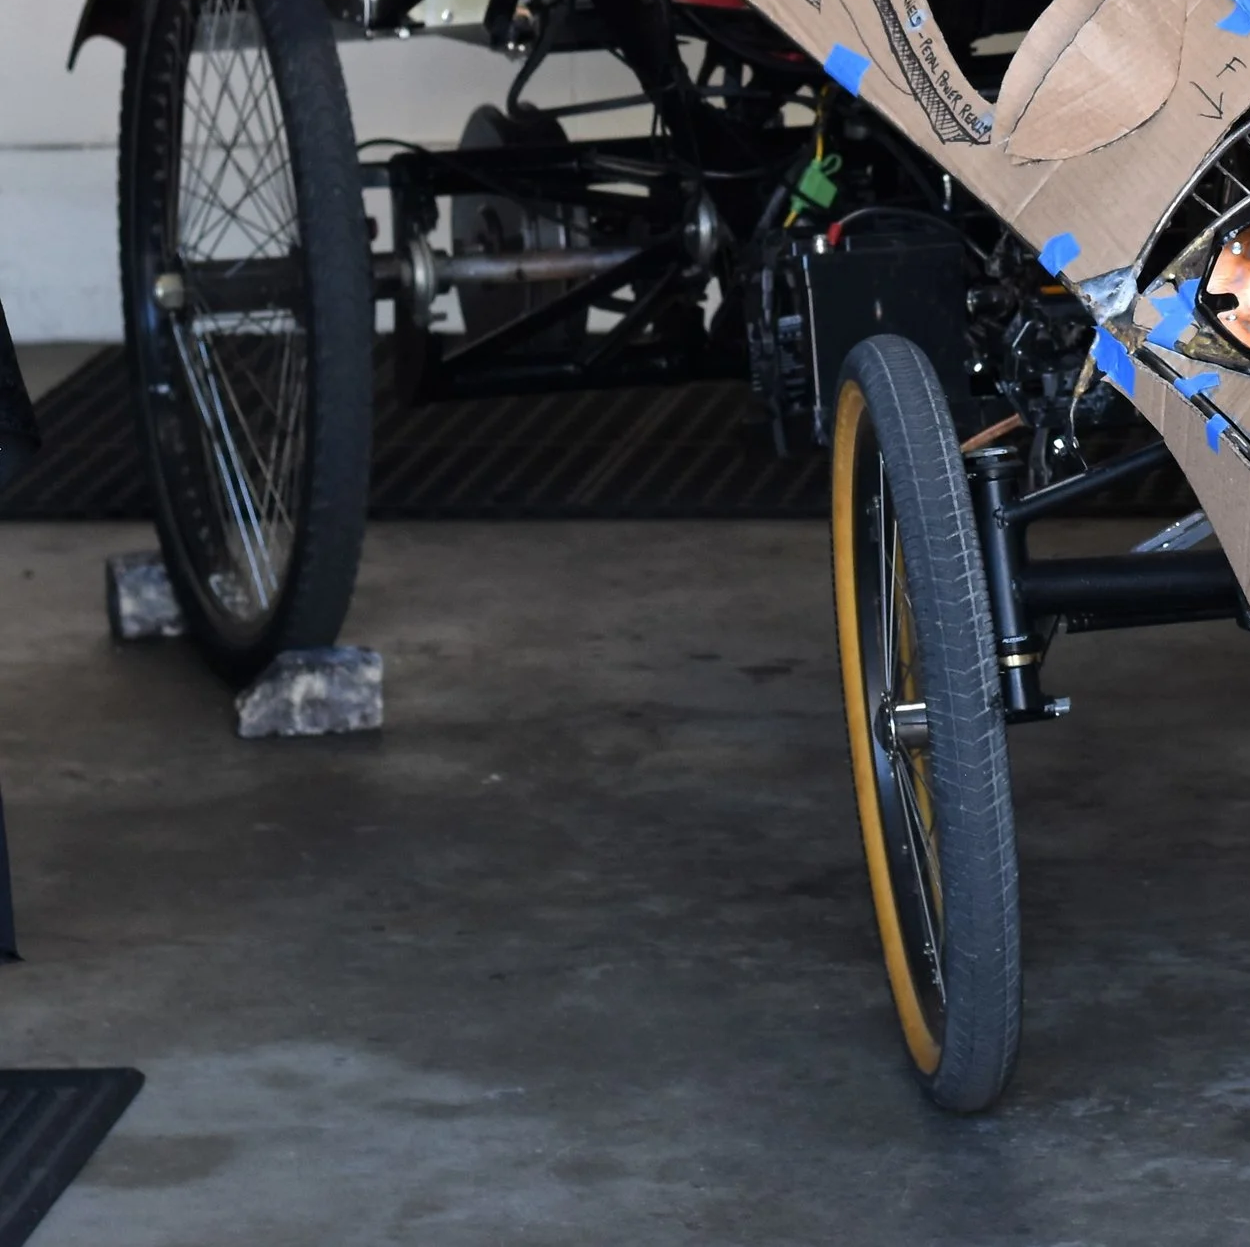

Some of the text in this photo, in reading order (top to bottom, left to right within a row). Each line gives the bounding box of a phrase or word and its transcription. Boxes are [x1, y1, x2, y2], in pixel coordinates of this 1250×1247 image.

[920, 38, 939, 75] PEDAL
[935, 70, 963, 111] POWER
[1216, 56, 1247, 78] F
